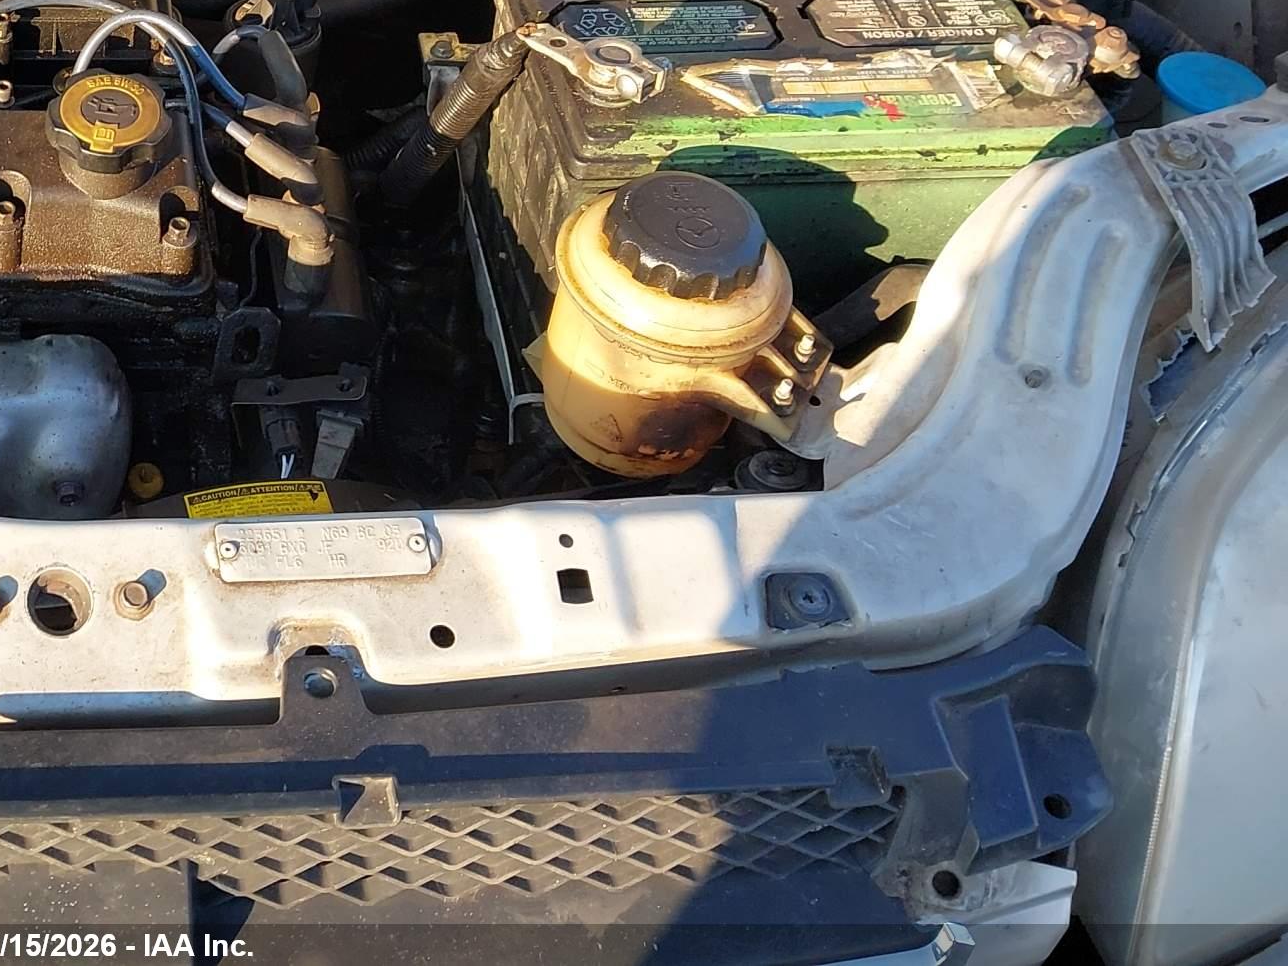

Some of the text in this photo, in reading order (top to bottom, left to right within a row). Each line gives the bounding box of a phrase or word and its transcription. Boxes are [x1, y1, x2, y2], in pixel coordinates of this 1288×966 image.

[861, 30, 913, 39] POISON
[927, 28, 984, 37] DANGER
[86, 76, 112, 89] SAE
